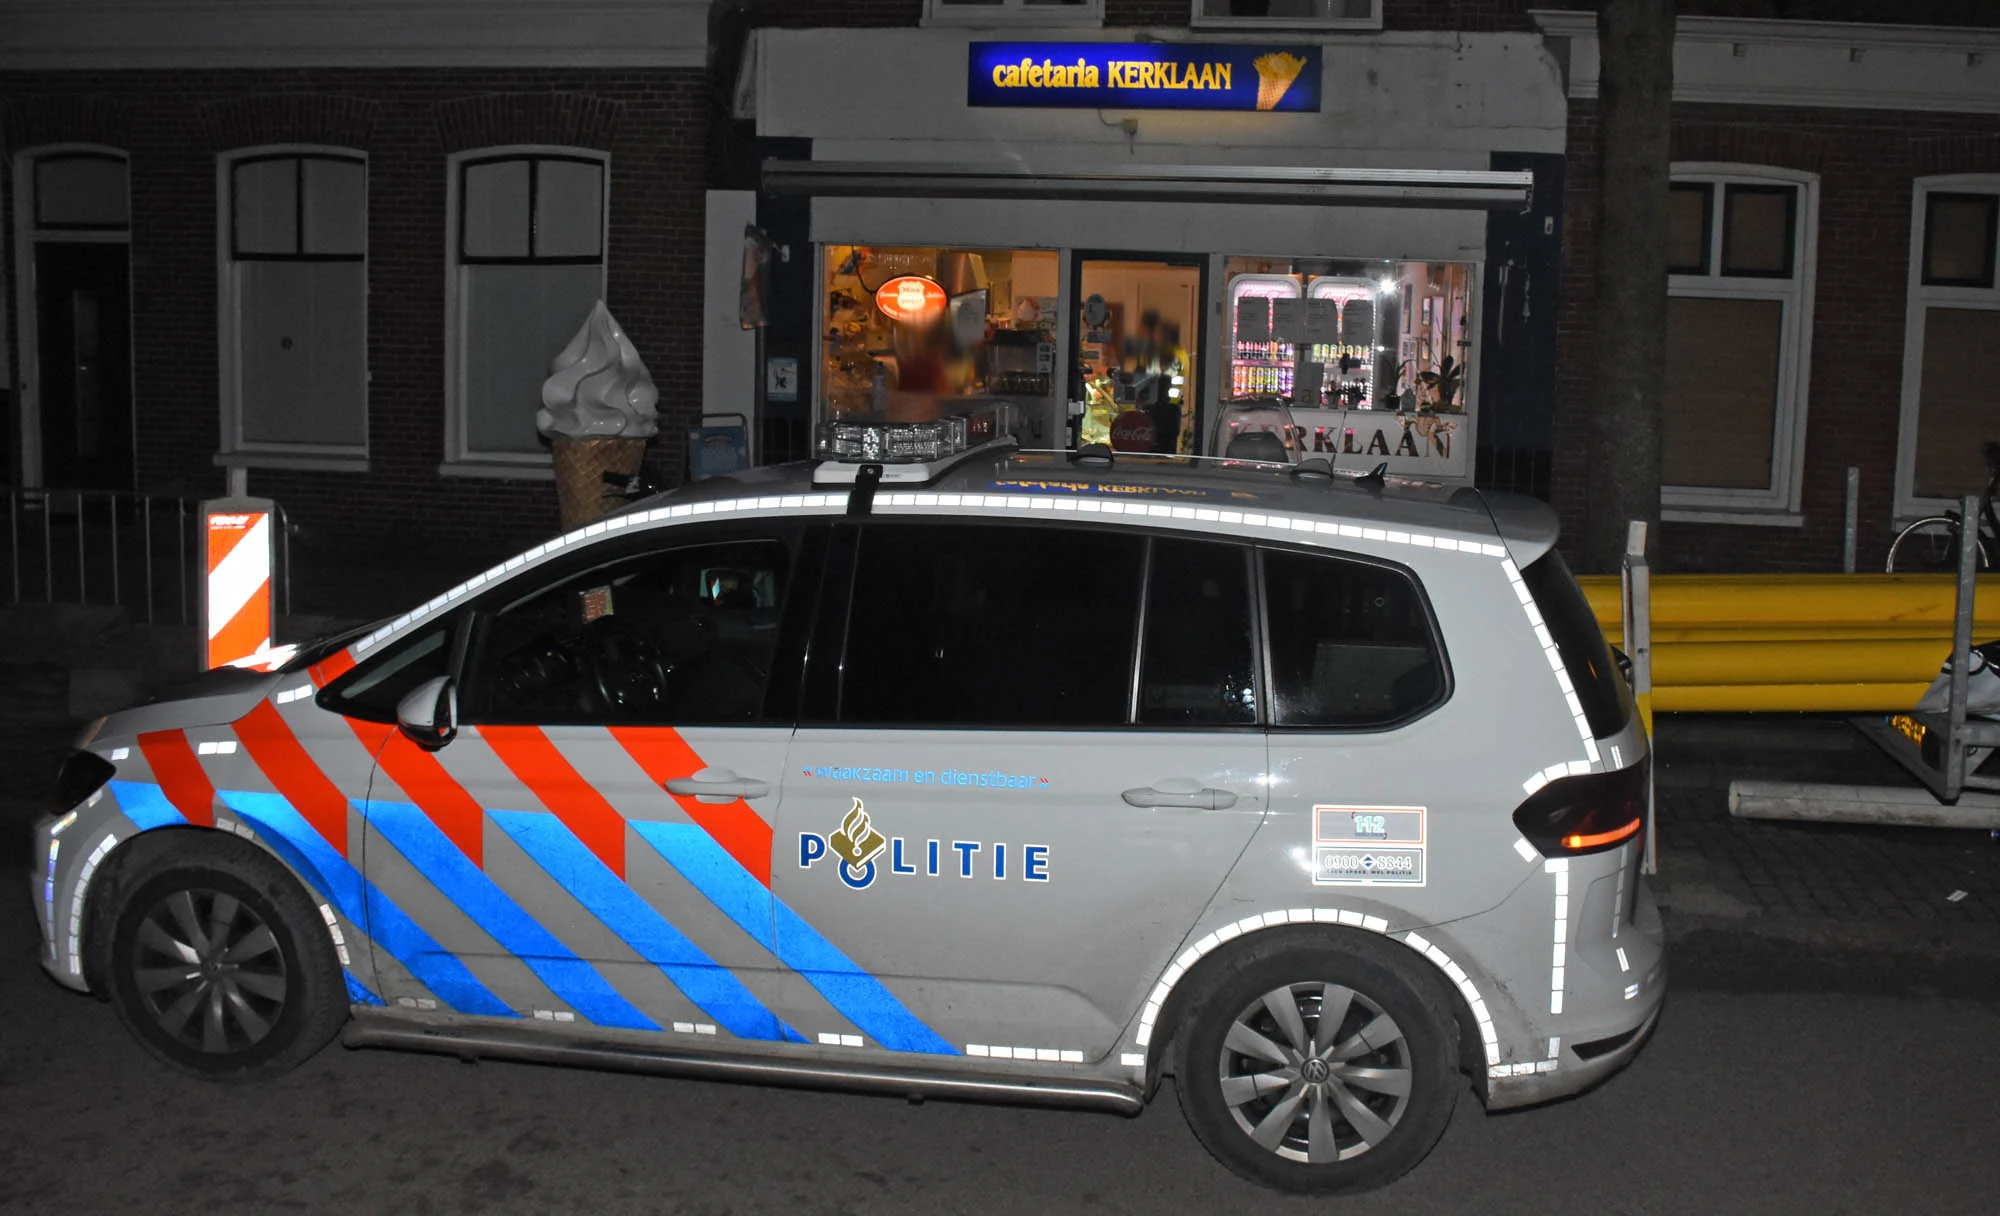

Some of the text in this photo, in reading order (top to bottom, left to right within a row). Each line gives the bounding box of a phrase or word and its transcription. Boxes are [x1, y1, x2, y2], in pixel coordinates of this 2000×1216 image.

[992, 57, 1232, 90] cafetaria KERKLAAN
[1284, 424, 1451, 459] RKLAAN
[914, 771, 936, 784] en
[1354, 815, 1385, 833] 112
[799, 831, 1050, 890] POLITIE
[1324, 855, 1412, 870] 0900 8844
